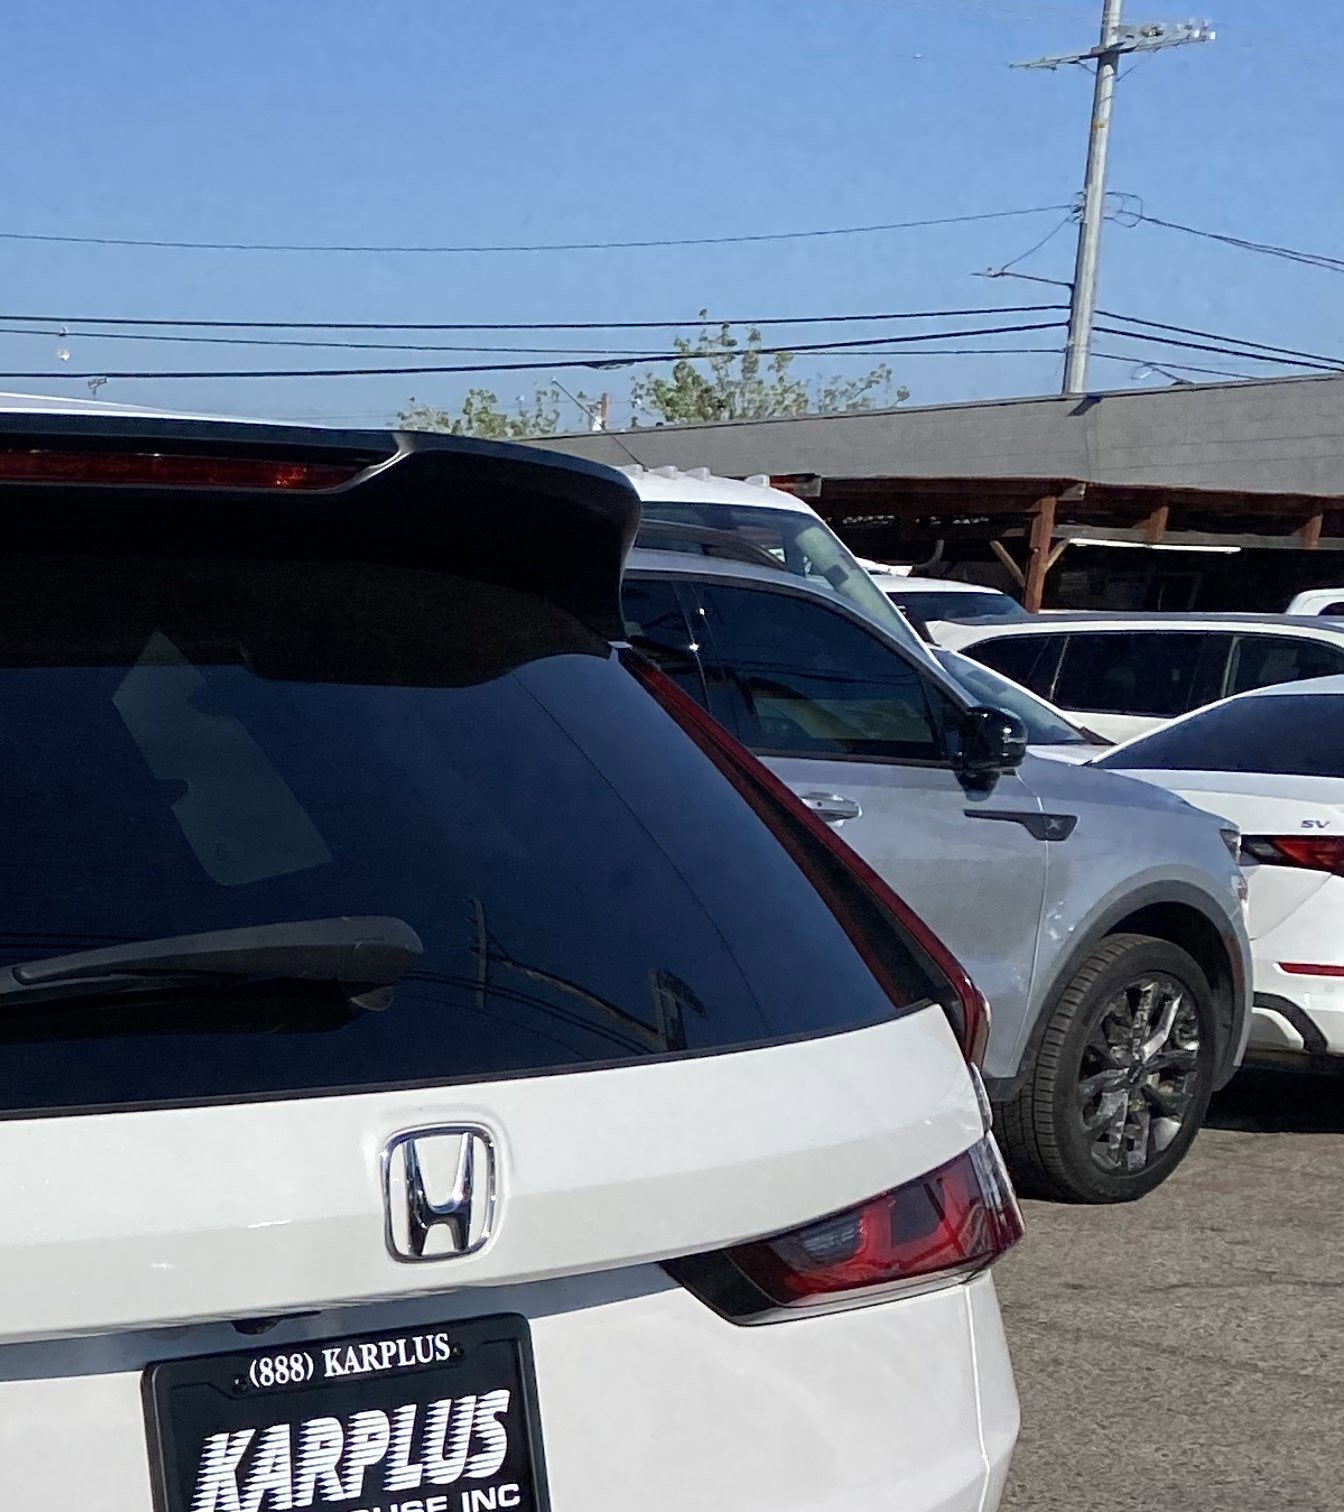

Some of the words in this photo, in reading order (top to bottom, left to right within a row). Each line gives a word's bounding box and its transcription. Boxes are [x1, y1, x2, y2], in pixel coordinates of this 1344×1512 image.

[1301, 819, 1330, 828] SV
[248, 1352, 314, 1388] (888)
[323, 1333, 452, 1377] KARPLUS
